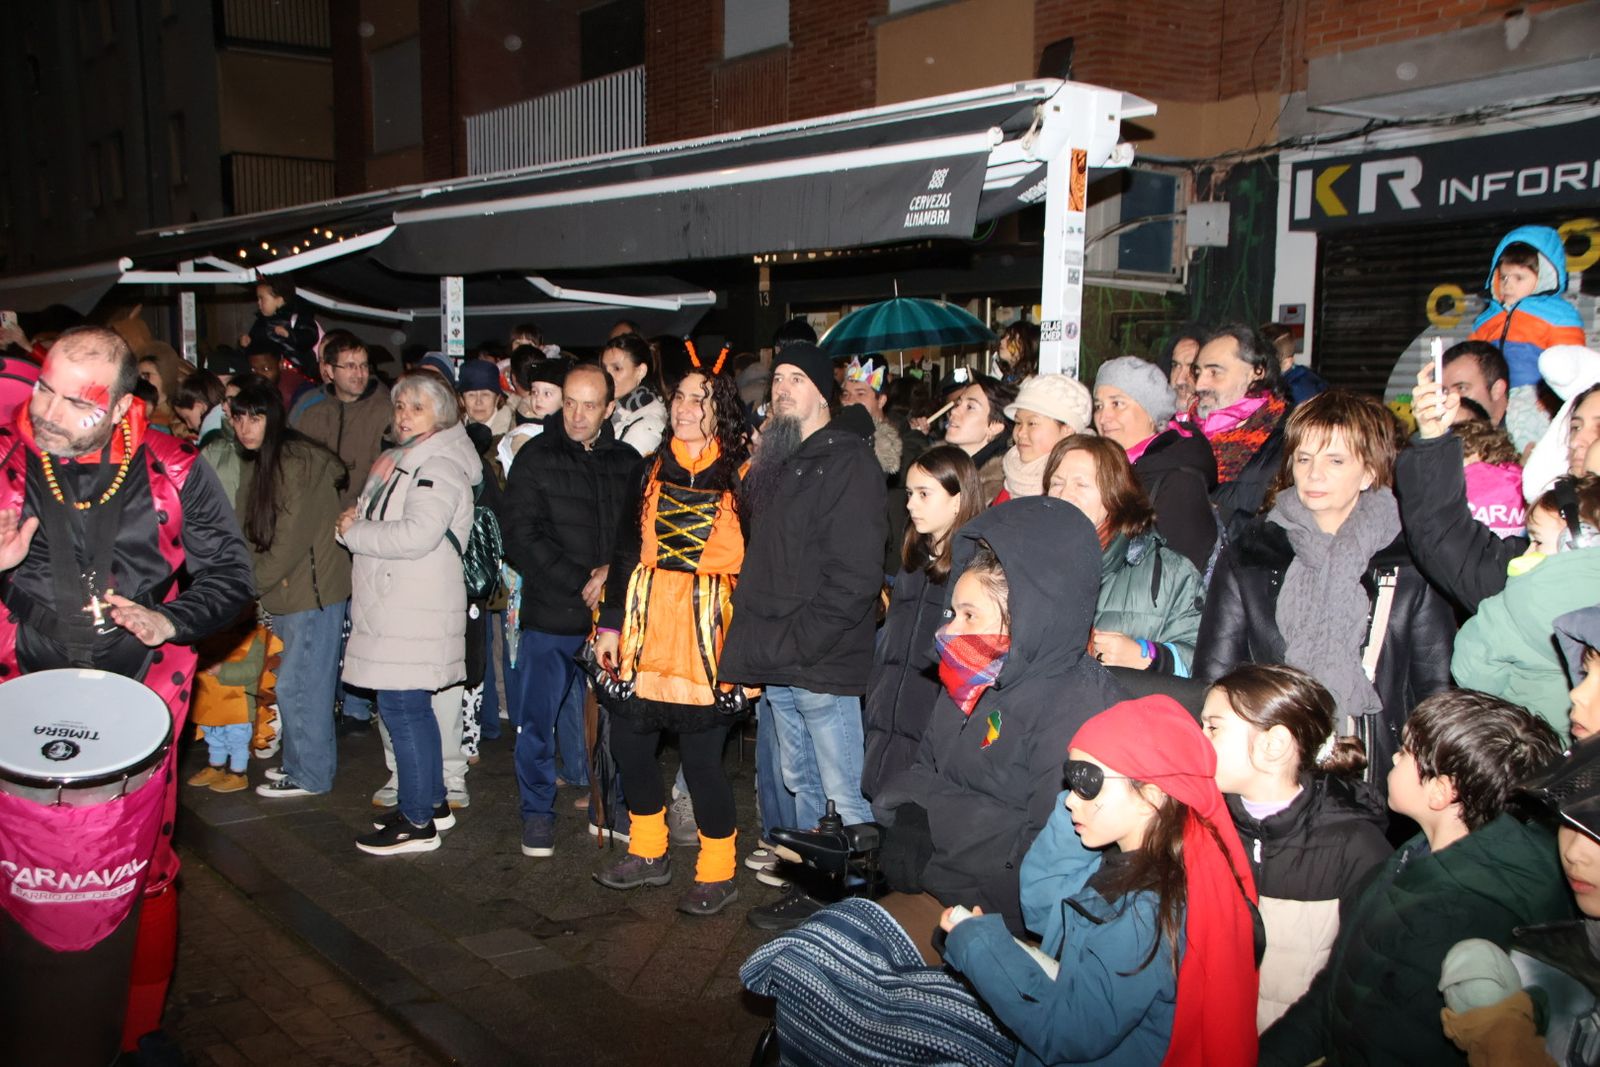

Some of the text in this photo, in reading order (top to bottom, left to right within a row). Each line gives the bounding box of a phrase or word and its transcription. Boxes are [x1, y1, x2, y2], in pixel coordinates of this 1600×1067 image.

[1294, 156, 1600, 221] KR INFOR
[909, 192, 952, 211] CERVEZAS
[903, 209, 951, 228] ALHAMBRA
[759, 292, 770, 308] 13
[33, 725, 100, 741] TIMBRA
[0, 858, 148, 890] CARNAVAL
[14, 883, 133, 901] BARRIO DEL OESTE
